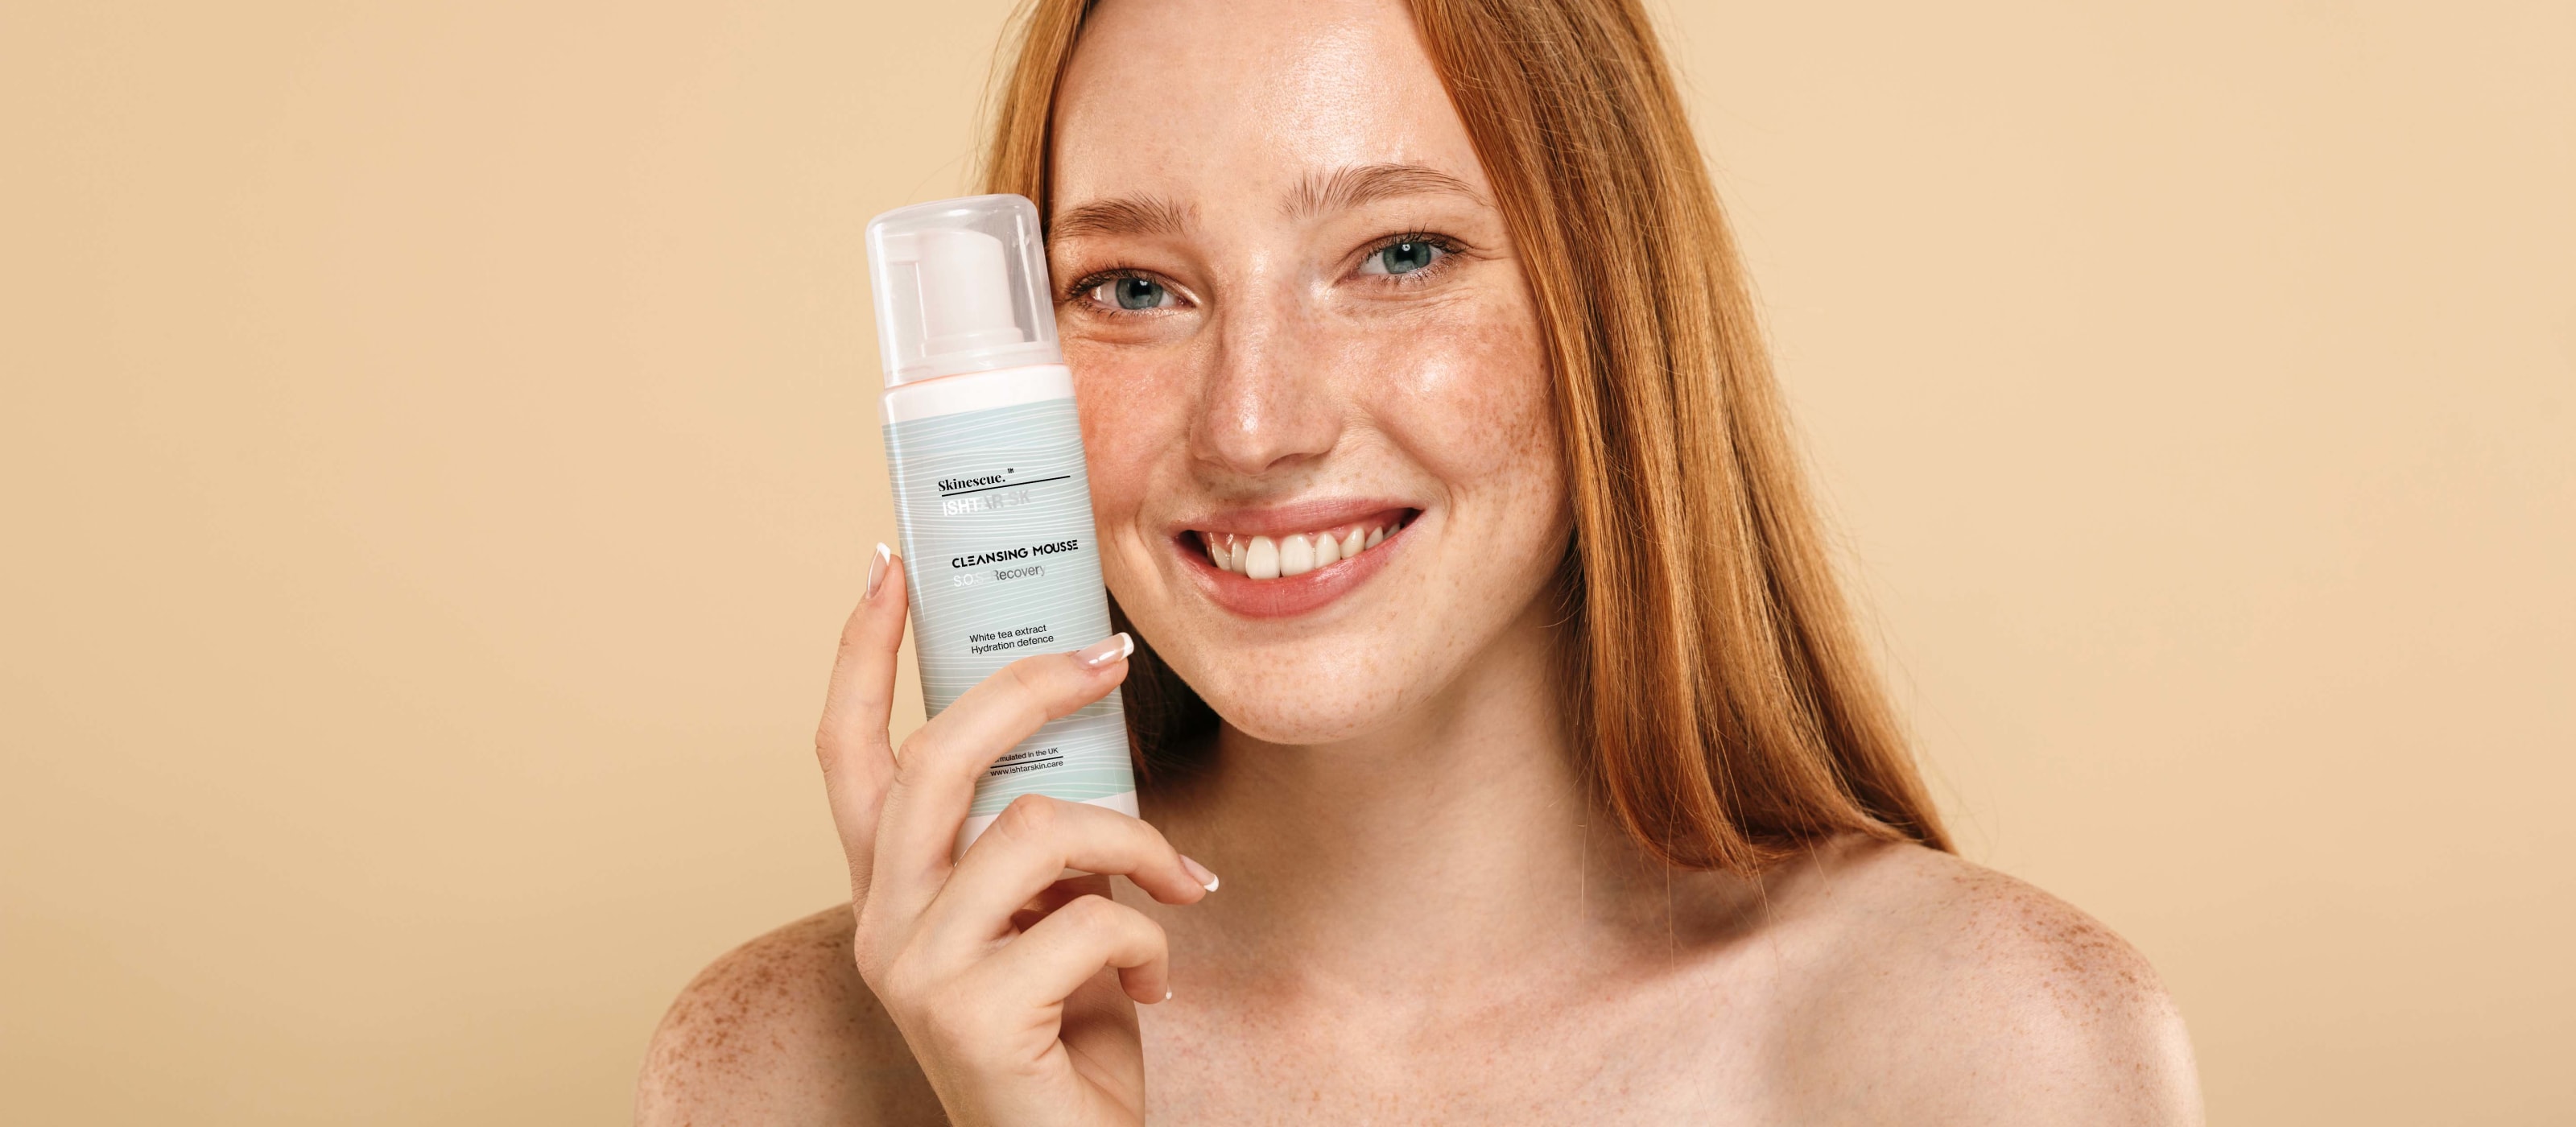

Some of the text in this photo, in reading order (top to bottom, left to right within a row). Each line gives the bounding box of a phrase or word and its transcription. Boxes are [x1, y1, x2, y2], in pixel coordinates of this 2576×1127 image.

[938, 474, 1005, 491] Skinescue.
[952, 539, 1079, 568] CLEANSING MOUSSE
[991, 565, 1046, 581] Recovery
[969, 625, 1046, 643] White tea extract
[971, 635, 1054, 654] Hydration defence
[1047, 747, 1059, 755] UK
[990, 761, 1063, 776] www.ishtarskin.care
